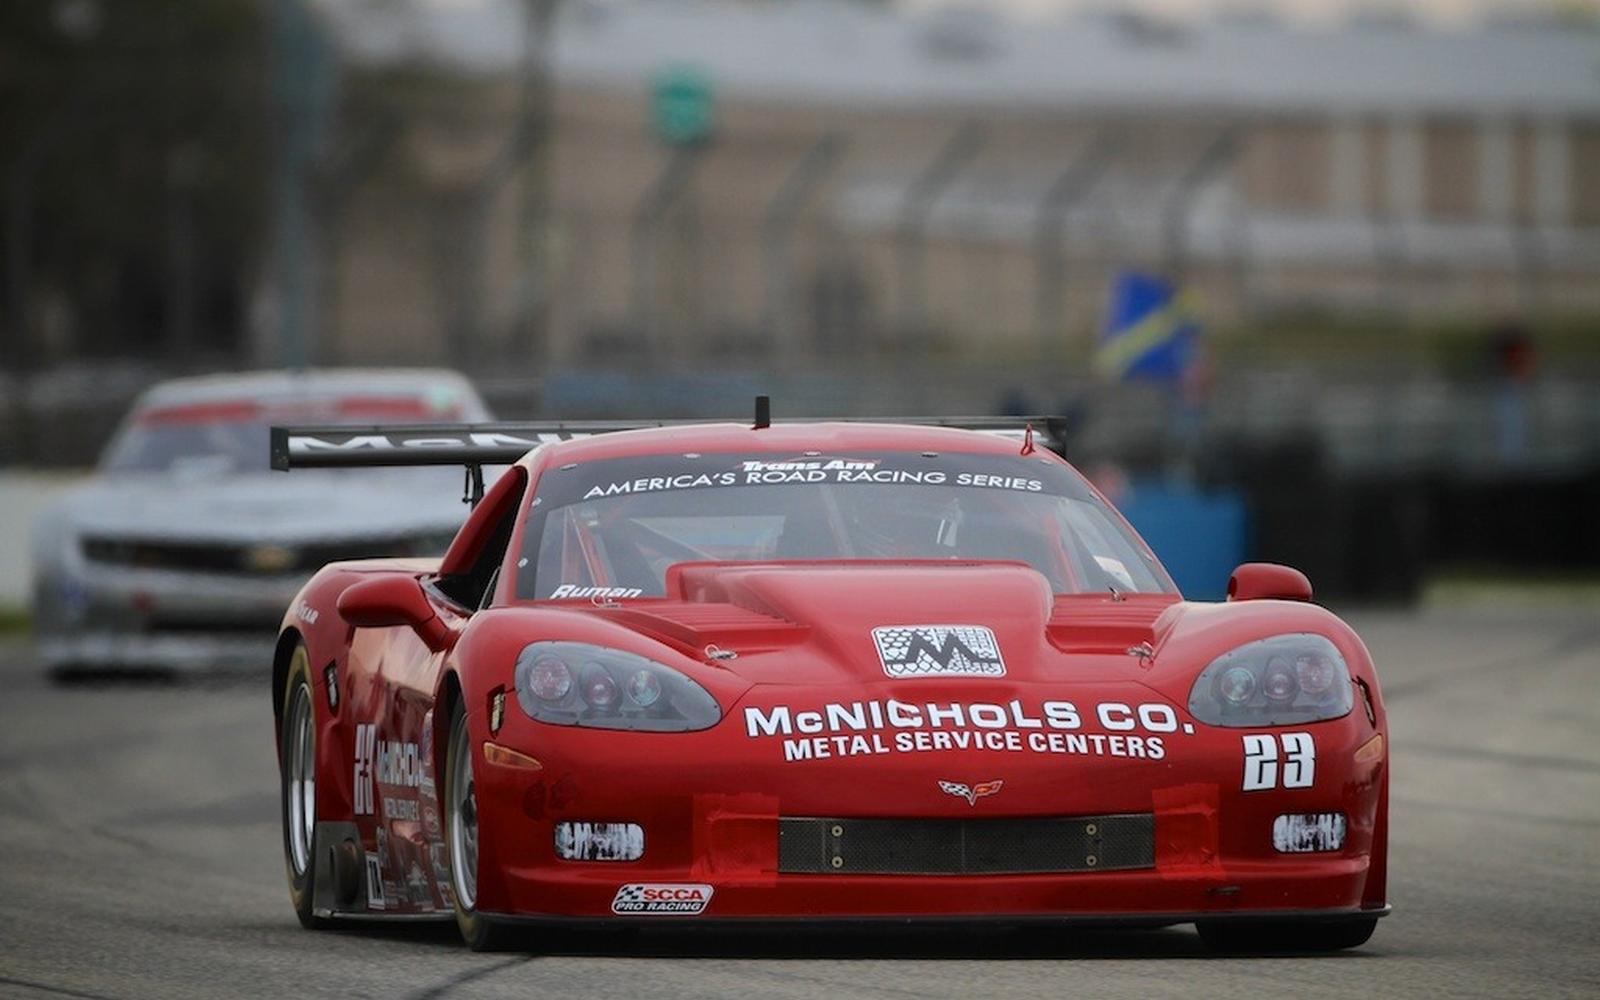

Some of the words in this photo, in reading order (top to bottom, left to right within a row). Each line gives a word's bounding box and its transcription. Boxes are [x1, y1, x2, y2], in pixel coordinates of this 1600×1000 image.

[742, 460, 820, 471] Trans
[823, 460, 875, 470] Am
[583, 472, 736, 499] AMERICA'S
[746, 471, 827, 483] ROAD
[837, 471, 947, 483] RACING
[957, 473, 1042, 491] SERIES
[550, 584, 642, 599] Ruman
[744, 699, 1081, 737] McNICHOLS
[1096, 703, 1195, 734] CO.
[784, 734, 890, 761] METAL
[895, 731, 1023, 752] SERVICE
[1028, 732, 1165, 760] CENTERS
[1242, 732, 1316, 791] 23
[643, 889, 704, 900] SCCA
[615, 902, 644, 911] PRO
[646, 902, 702, 911] RACING
